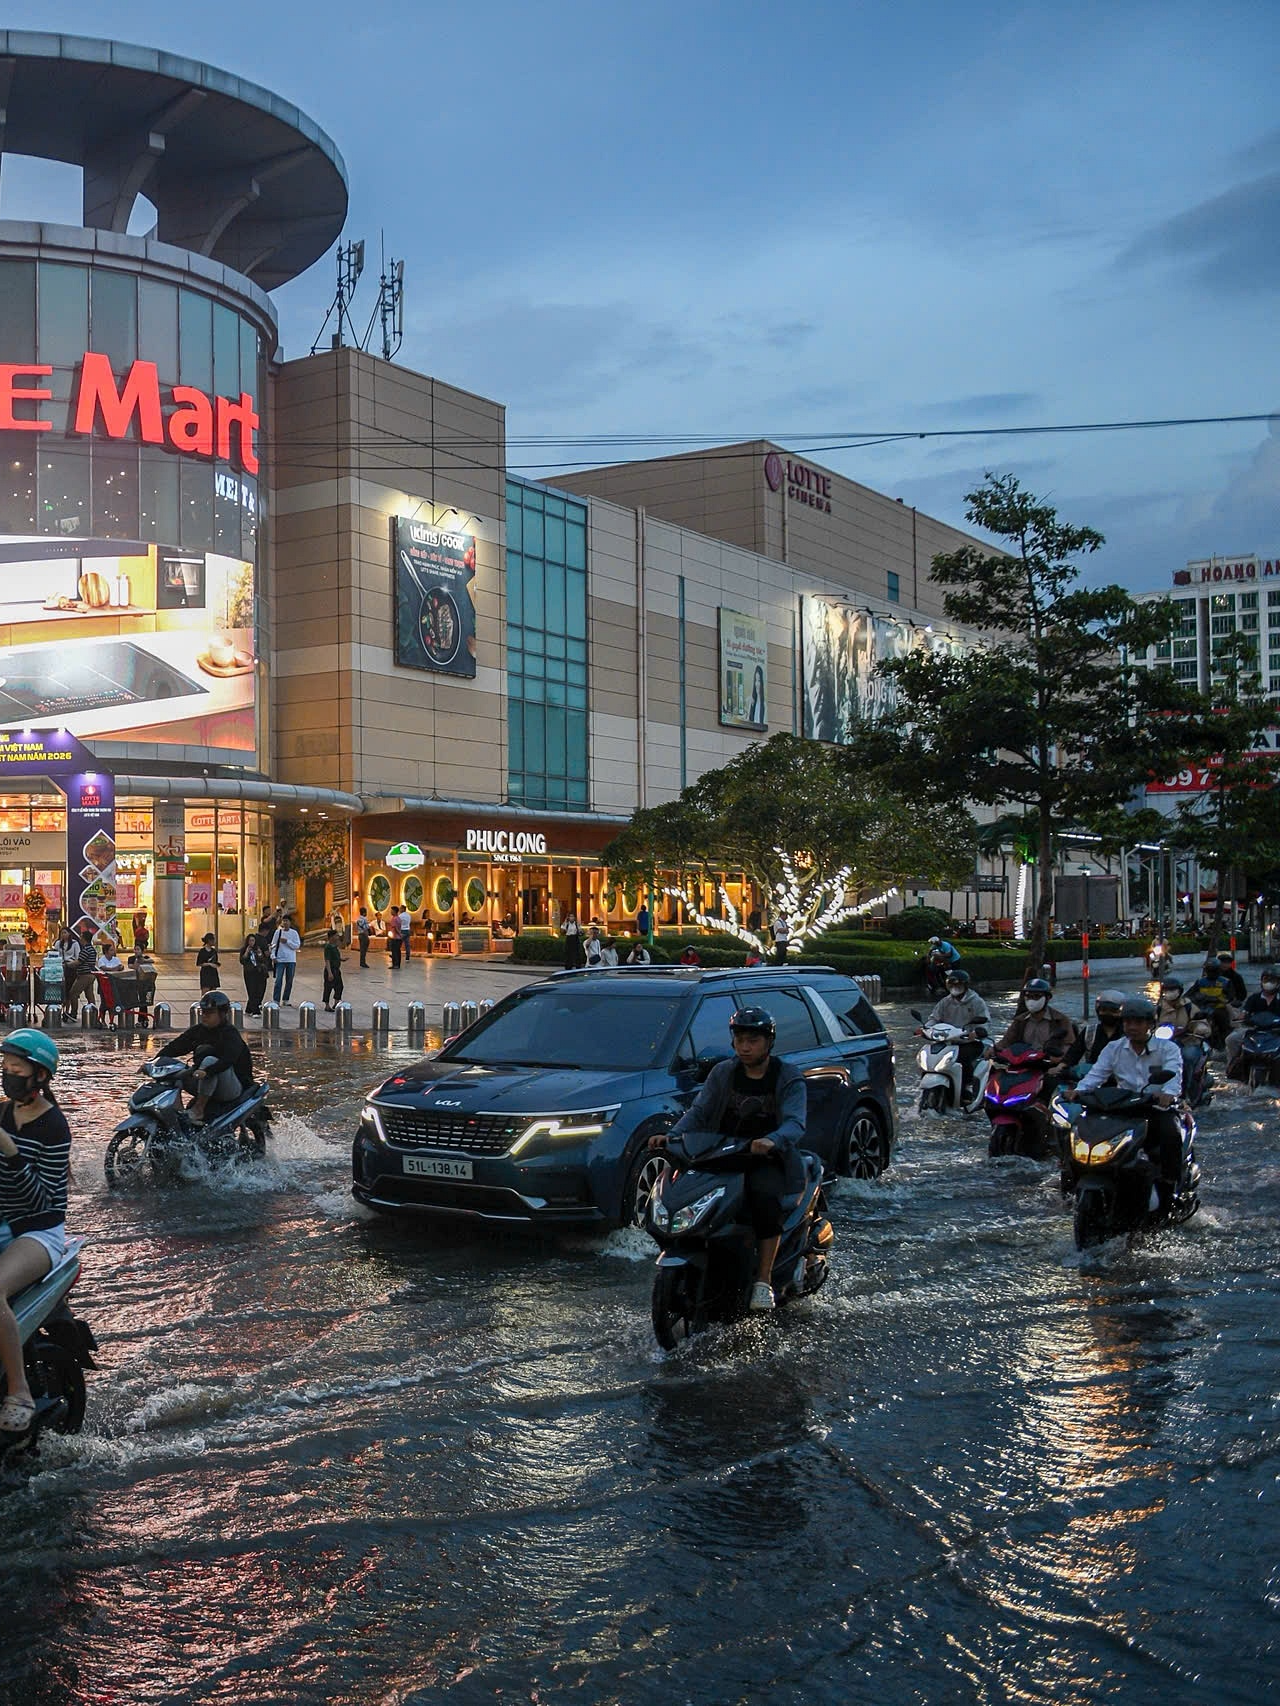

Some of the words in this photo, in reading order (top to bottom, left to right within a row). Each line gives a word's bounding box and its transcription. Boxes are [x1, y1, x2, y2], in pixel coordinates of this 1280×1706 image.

[74, 352, 260, 475] Mart
[786, 460, 832, 498] LOTTE
[788, 485, 832, 513] CINEMA
[8, 753, 26, 762] NAM
[24, 743, 44, 751] NAM
[509, 832, 546, 854] LONG
[408, 1159, 467, 1177] 51L-138.14
